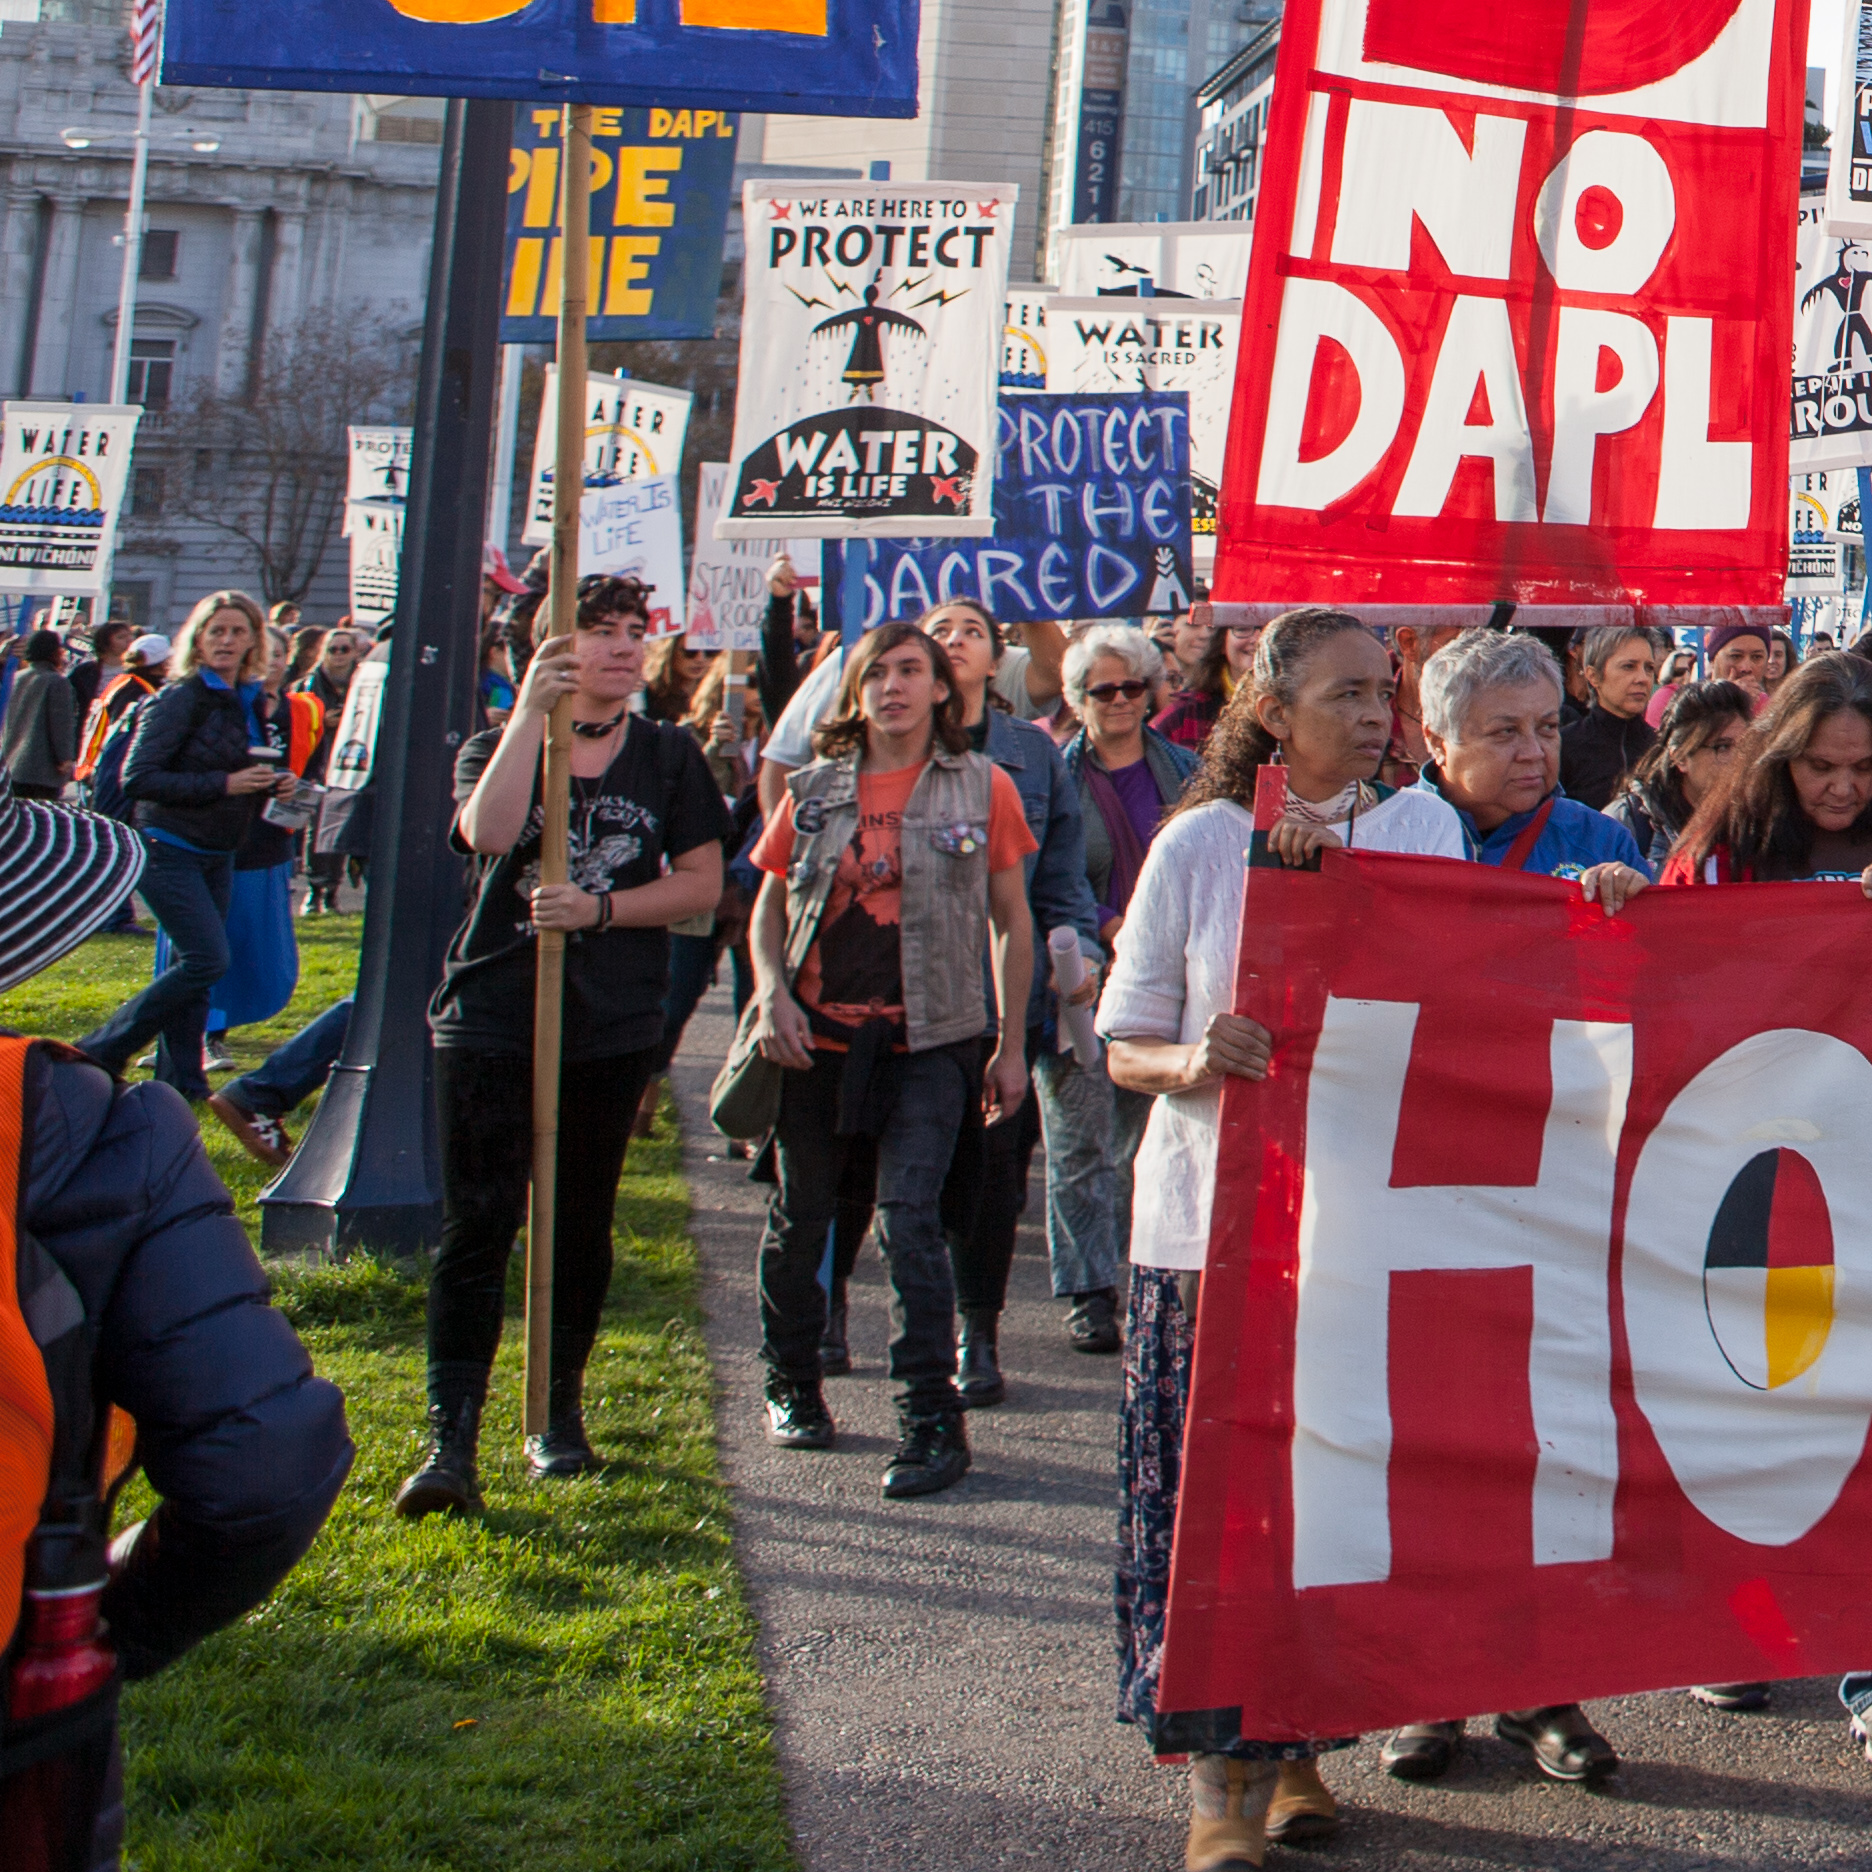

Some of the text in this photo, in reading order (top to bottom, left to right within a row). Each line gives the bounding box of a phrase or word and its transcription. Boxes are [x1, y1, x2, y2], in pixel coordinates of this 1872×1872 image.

[531, 106, 734, 139] TE DAPL
[798, 198, 967, 219] WE ARE HERE TO
[1328, 90, 1677, 295] NO
[769, 224, 996, 269] PROTECT
[505, 235, 661, 317] INE
[1003, 301, 1047, 328] TER
[1074, 318, 1225, 349] WATER
[1003, 345, 1029, 370] FE
[1103, 351, 1197, 365] IS SACRED
[591, 398, 664, 435] ATER
[1255, 278, 1754, 531] DAPL
[20, 426, 110, 458] WATER
[355, 440, 413, 454] PROTE
[774, 429, 961, 477] WATER
[996, 406, 1187, 481] PROTECT
[597, 446, 638, 475] IFE
[26, 478, 82, 506] LIFE
[803, 475, 907, 498] IS LIFE
[579, 494, 640, 528] WATER
[1027, 477, 1179, 540] THE
[1841, 521, 1863, 532] NO
[692, 562, 768, 609] STAND
